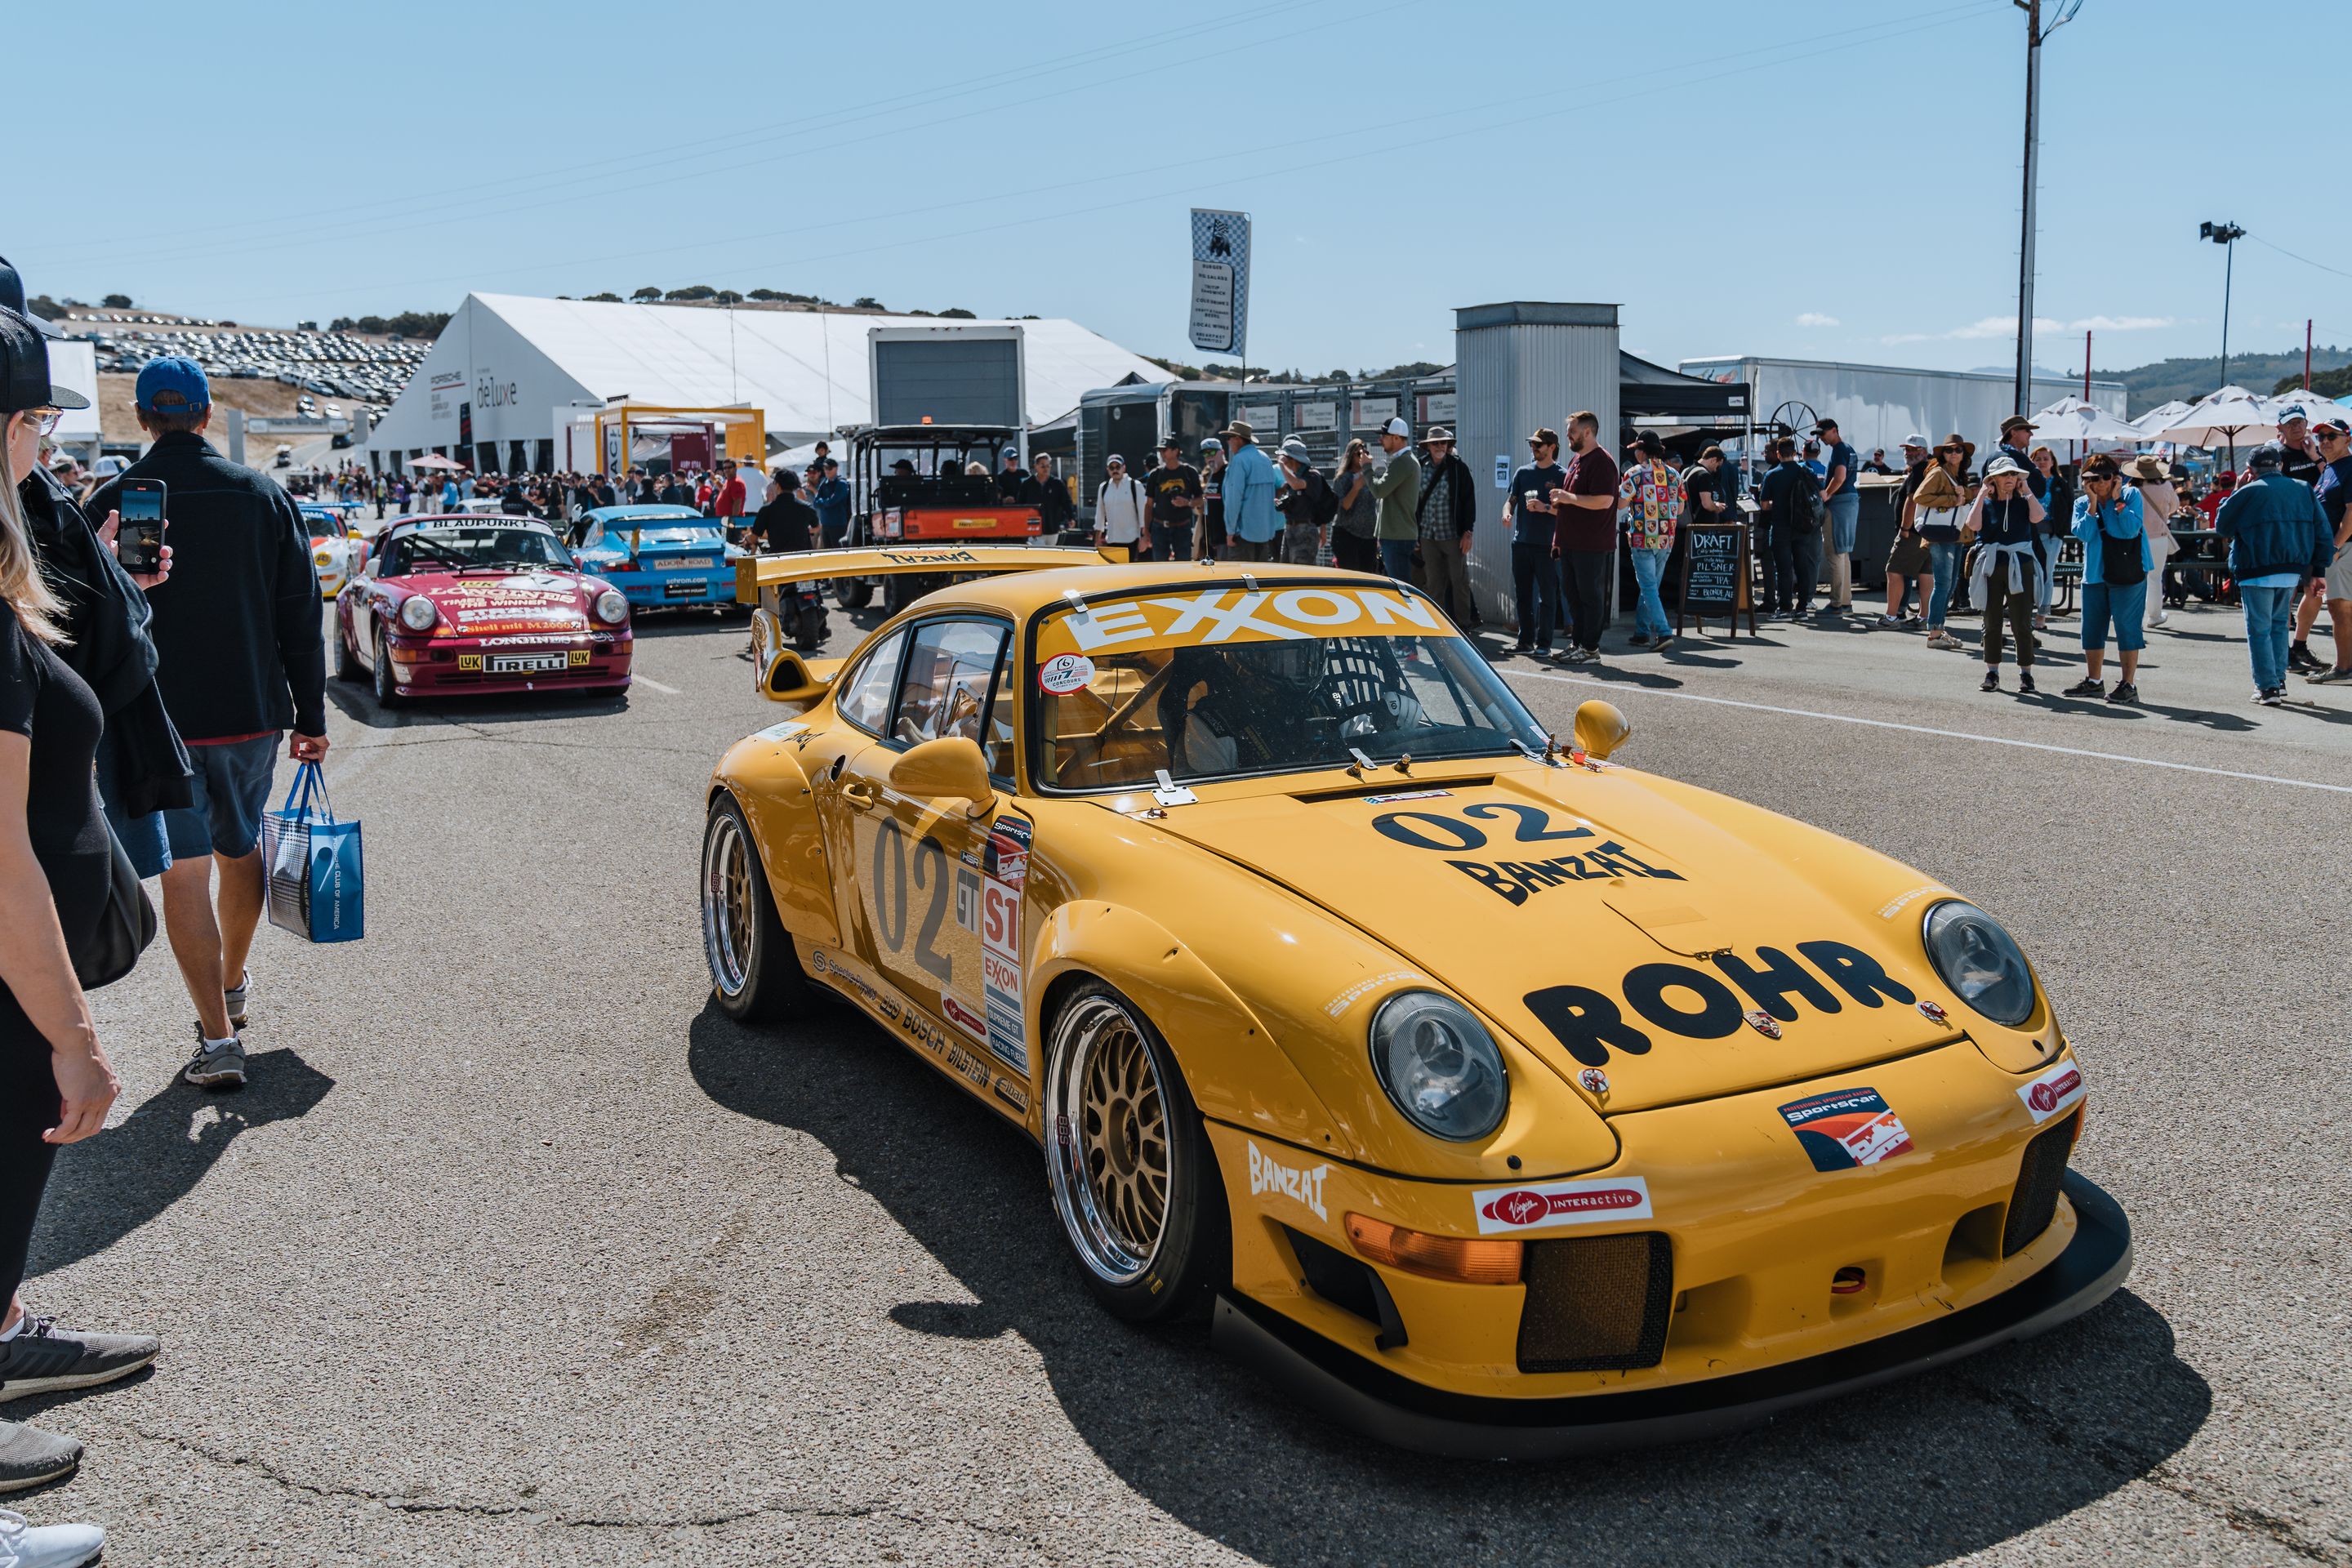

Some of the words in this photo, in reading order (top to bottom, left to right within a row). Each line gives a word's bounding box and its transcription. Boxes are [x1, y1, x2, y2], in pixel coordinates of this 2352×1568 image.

[477, 376, 517, 408] deluxe
[433, 518, 530, 528] BLAUPUNKT
[1694, 534, 1733, 550] DRAFT
[880, 550, 980, 564] BANZAI
[1697, 562, 1735, 572] PILSNER
[428, 586, 577, 604] LONGINES
[666, 577, 708, 585] schrom.com
[1703, 588, 1723, 597] BLONDE
[1062, 588, 1441, 651] EXXON
[479, 635, 572, 646] LONGINES
[484, 653, 566, 671] PIRELLI
[1052, 677, 1082, 687] CONCOURS
[1371, 803, 1596, 852] 02
[962, 852, 979, 867] HSR
[1442, 840, 1690, 907] BANZAI
[334, 890, 341, 898] OF
[873, 816, 952, 985] 02
[986, 887, 1018, 951] S1
[985, 956, 1018, 992] EXXON
[1522, 940, 1918, 1067] ROHR
[988, 1008, 1011, 1031] SUPREME
[1011, 1022, 1019, 1036] GT
[902, 1007, 947, 1055] BOSCH
[947, 1040, 991, 1089] BILSTEIN
[991, 1035, 1010, 1058] RACING
[1009, 1045, 1026, 1066] FUELS
[1783, 1099, 1823, 1112] PROFESSIONAL
[1822, 1093, 1853, 1103] SPORTSCAR
[1852, 1089, 1872, 1099] RACING
[1057, 1114, 1070, 1146] BBS
[1248, 1138, 1328, 1223] BANZAI
[1508, 1192, 1539, 1224] Virgin
